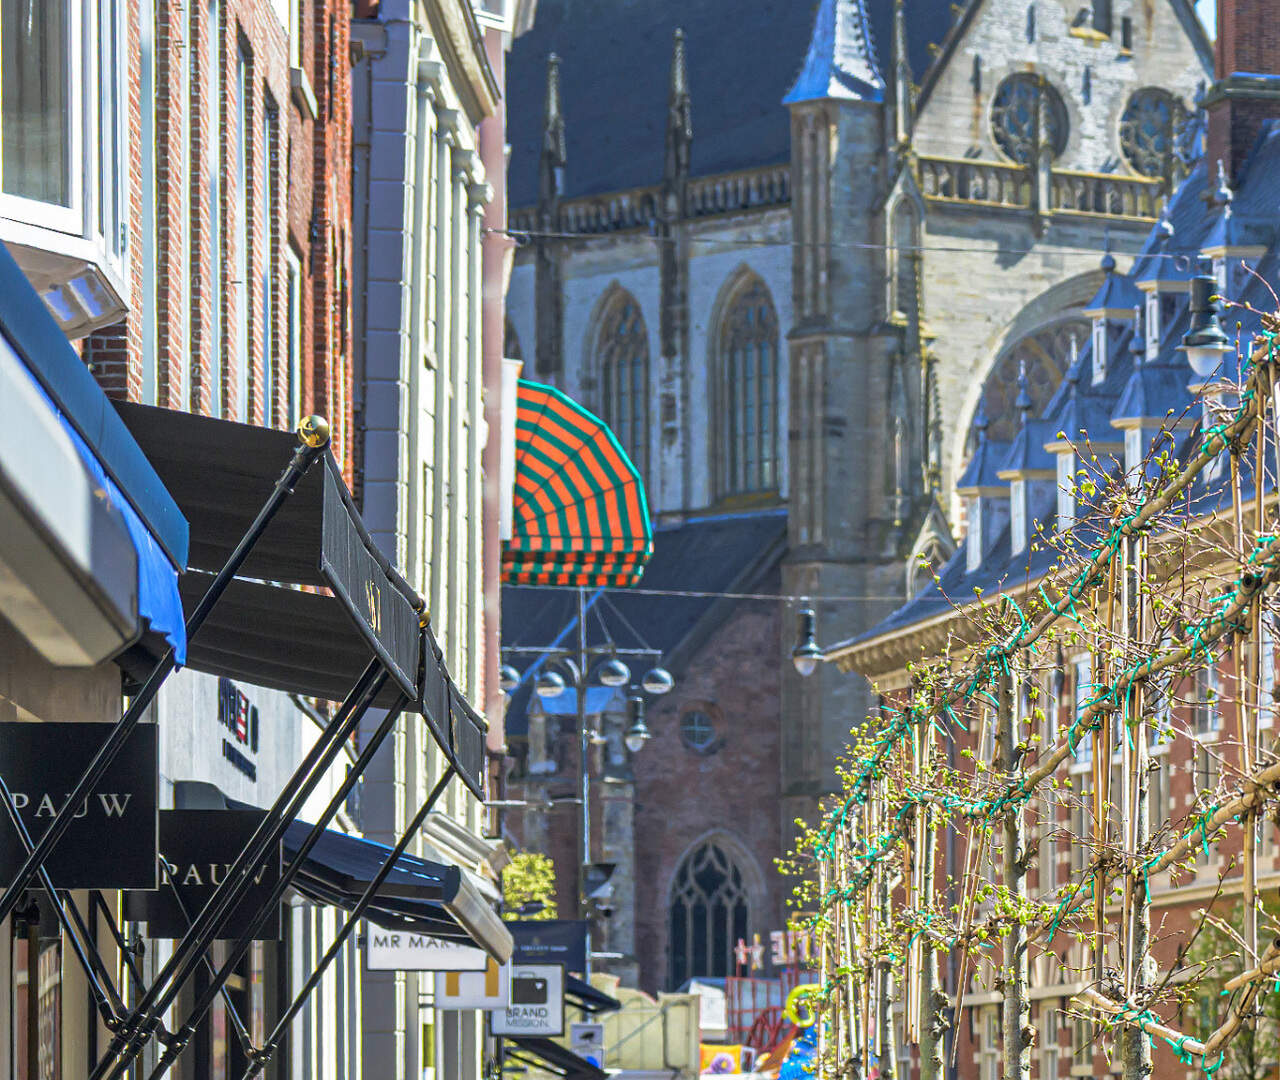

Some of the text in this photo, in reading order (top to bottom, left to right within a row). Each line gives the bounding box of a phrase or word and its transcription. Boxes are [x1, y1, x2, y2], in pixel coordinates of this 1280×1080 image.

[10, 792, 132, 818] PAUW
[374, 935, 400, 948] MR
[506, 1008, 548, 1018] BRAND
